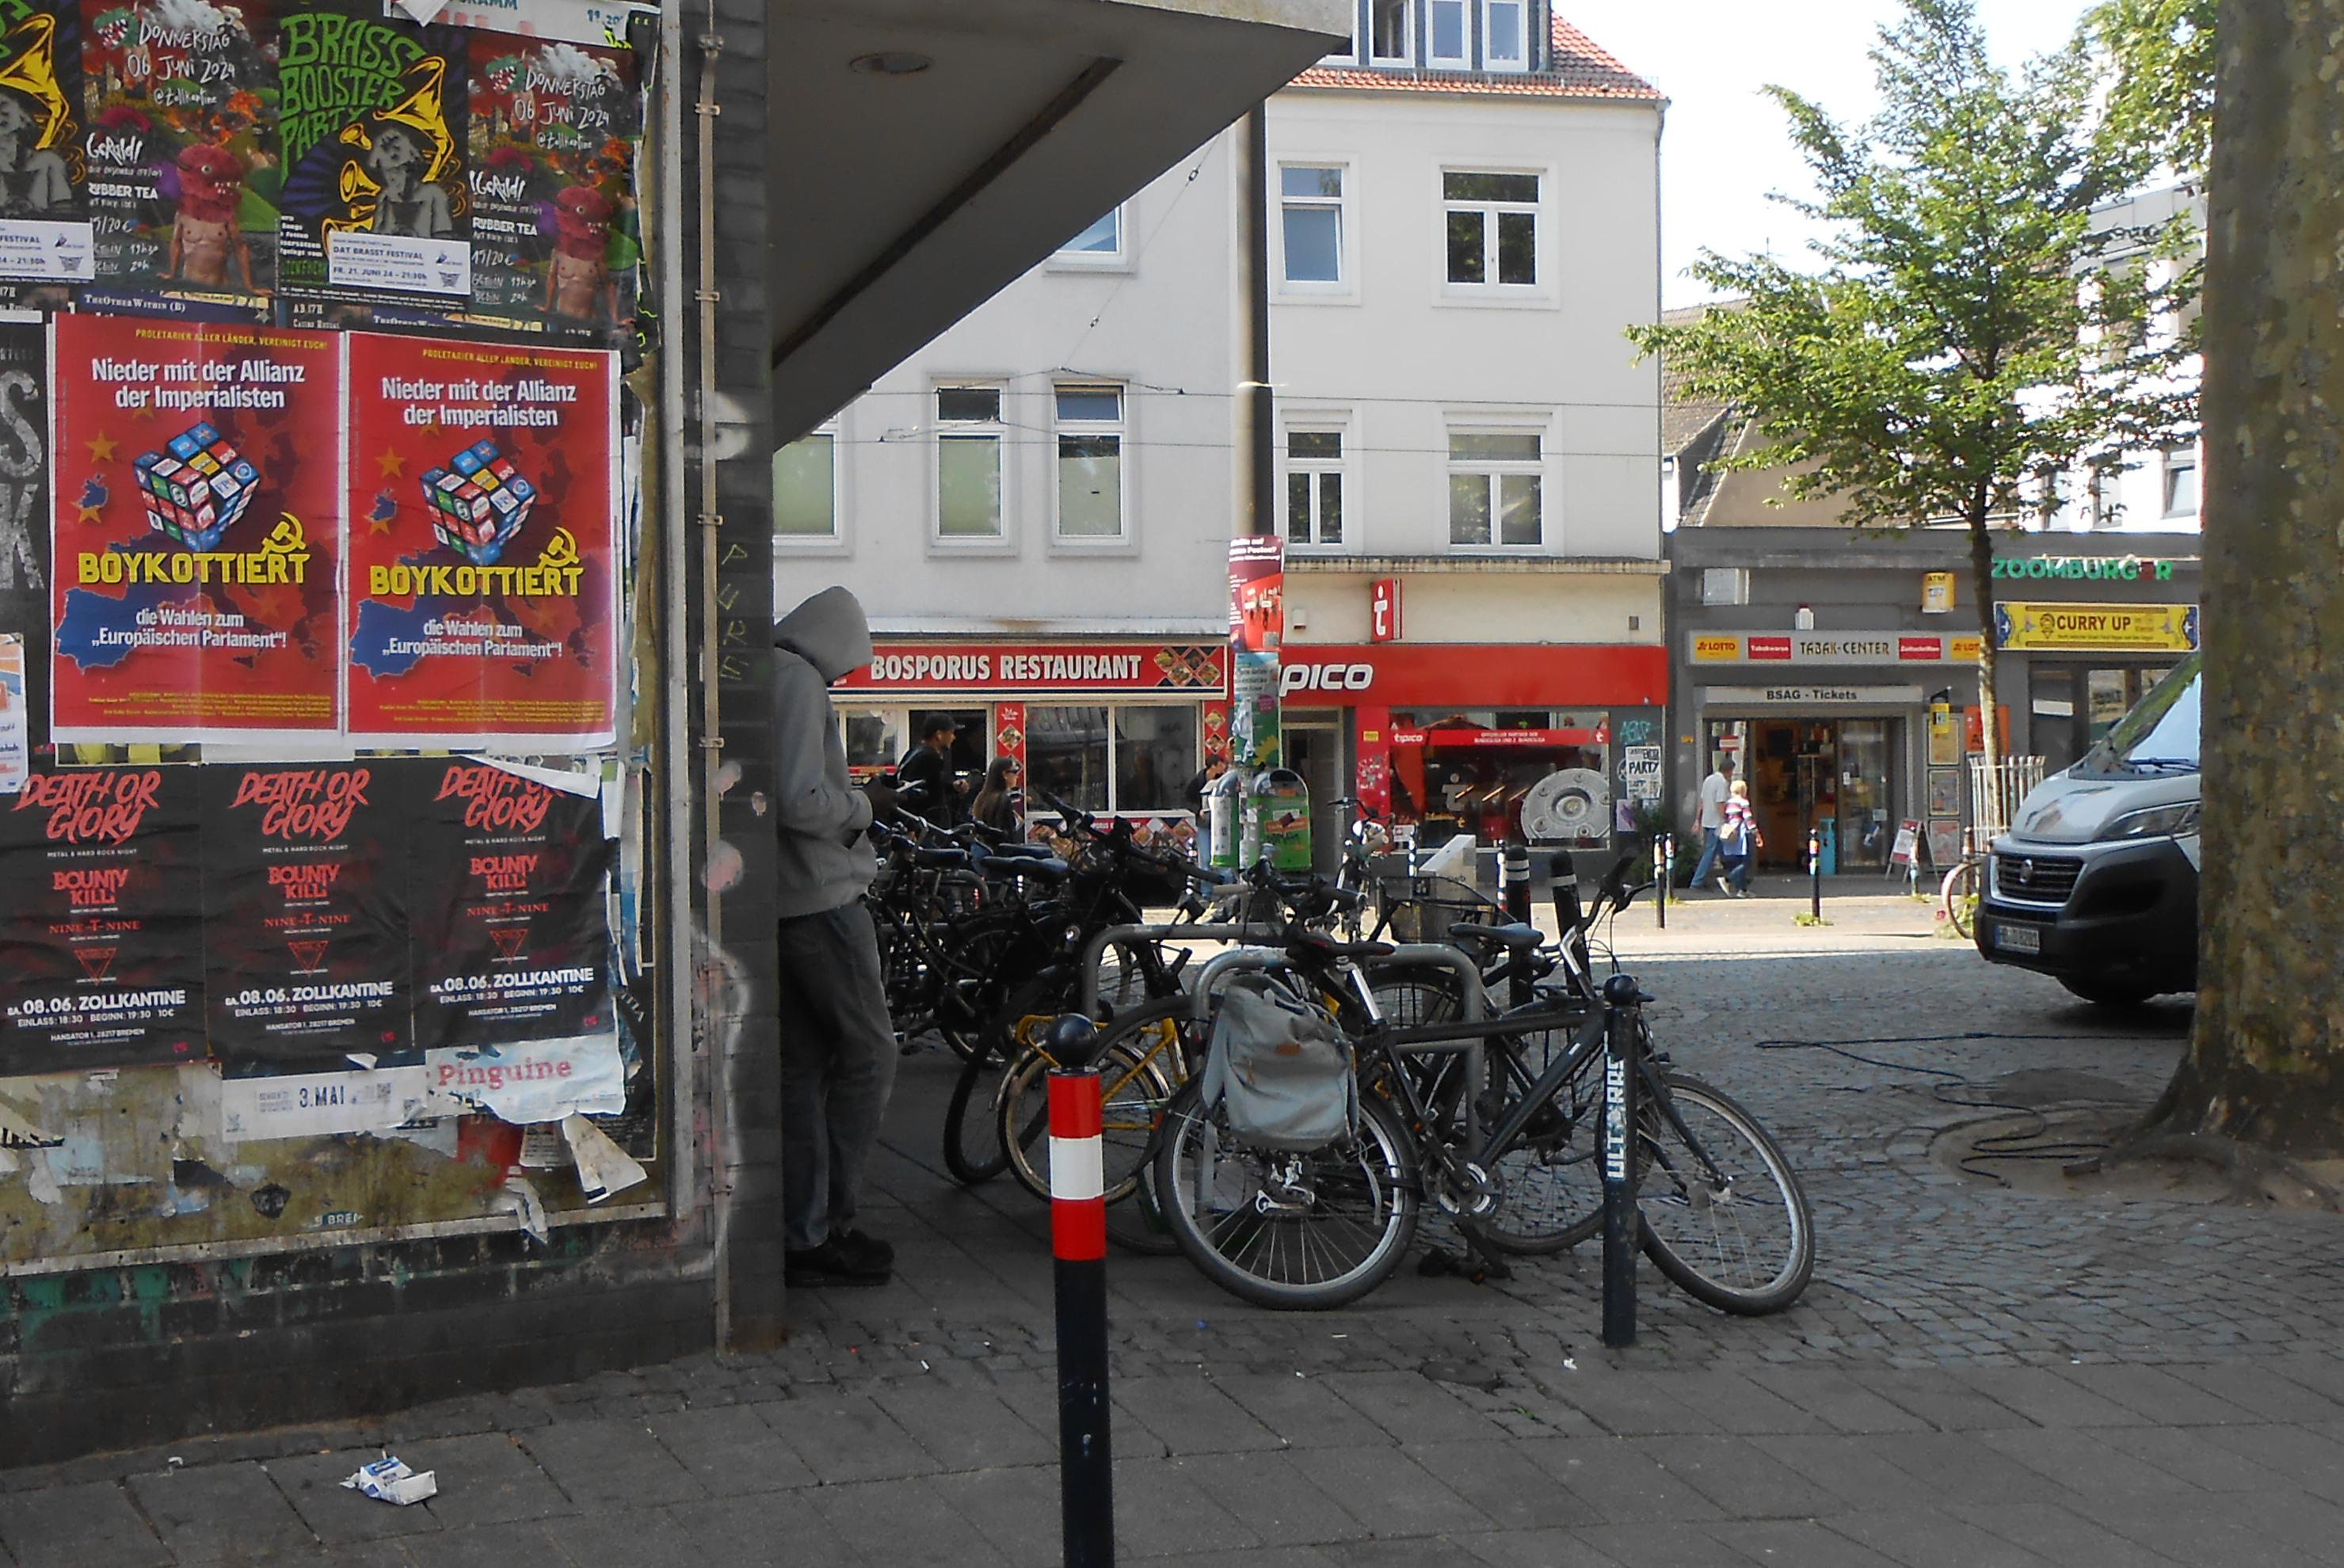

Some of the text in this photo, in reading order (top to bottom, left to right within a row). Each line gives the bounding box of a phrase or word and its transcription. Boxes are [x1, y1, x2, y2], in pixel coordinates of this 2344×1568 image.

[138, 21, 231, 52] DONNERSTAG
[279, 13, 428, 78] BRASS
[127, 54, 151, 77] 06
[200, 59, 235, 84] 2024
[279, 64, 406, 120] BOOSTER
[525, 68, 605, 99] DONNERSTAG
[515, 98, 535, 121] 06
[577, 107, 609, 131] 2024
[279, 105, 368, 192] PARTY
[135, 186, 158, 200] TEA
[472, 216, 538, 236] RUBBER TEA
[333, 245, 351, 254] DAT
[386, 249, 424, 260] FESTIVAL
[361, 268, 381, 276] JUNI
[135, 329, 328, 350] PROLETARIER ALLER LÄNDER, VEREINIGT EUCH!
[92, 357, 305, 384] Nieder mit der Allianz
[422, 348, 597, 370] PROLETARIER ALLER LÄNDER, VEREINIGT EUCH!
[115, 385, 285, 412] der Imperialisten
[382, 377, 577, 402] Nieder mit der Allianz
[403, 404, 558, 429] der Imperialisten
[78, 552, 311, 584] BOYKOTTIERT
[369, 565, 585, 596] BOYKOTTIERT
[135, 607, 244, 628] die Wahlen zum
[423, 618, 523, 638] die Wahlen zum
[2056, 615, 2131, 631] CURRY UP
[91, 626, 199, 649] „Europäischen
[382, 636, 481, 657] „Europäischen
[1708, 642, 1736, 651] LOTTO
[1800, 641, 1890, 656] TABAK-CENTER
[871, 654, 1142, 680] BOSPORUS RESTAURANT
[1278, 663, 1374, 698] pico
[1767, 689, 1858, 701] BSAG Tickets
[1394, 733, 1424, 744] tipico
[1629, 761, 1660, 775] PARTY
[11, 770, 162, 811] DEATH OR
[228, 768, 371, 809] DEATH OR
[46, 803, 147, 846] GLORY
[261, 799, 357, 842] GLORY
[464, 793, 554, 833] GLORY
[268, 864, 340, 886] BOUNTY
[470, 854, 539, 876] BOUNTY
[52, 868, 129, 890] BOUNTY
[444, 975, 491, 991] 08.06.
[493, 967, 594, 988] ZOLLKANTINE
[568, 985, 584, 994] 10€
[22, 997, 76, 1015] 08.06.
[78, 989, 185, 1011] ZOLLKANTINE
[239, 988, 290, 1005] 08.06.
[292, 981, 393, 1002] ZOLLKANTINE
[367, 999, 383, 1008] 10€
[158, 1008, 174, 1018] 10€
[528, 1003, 557, 1012] BREMEN
[116, 1028, 145, 1037] BREMEN
[438, 1058, 572, 1090] Pinguine
